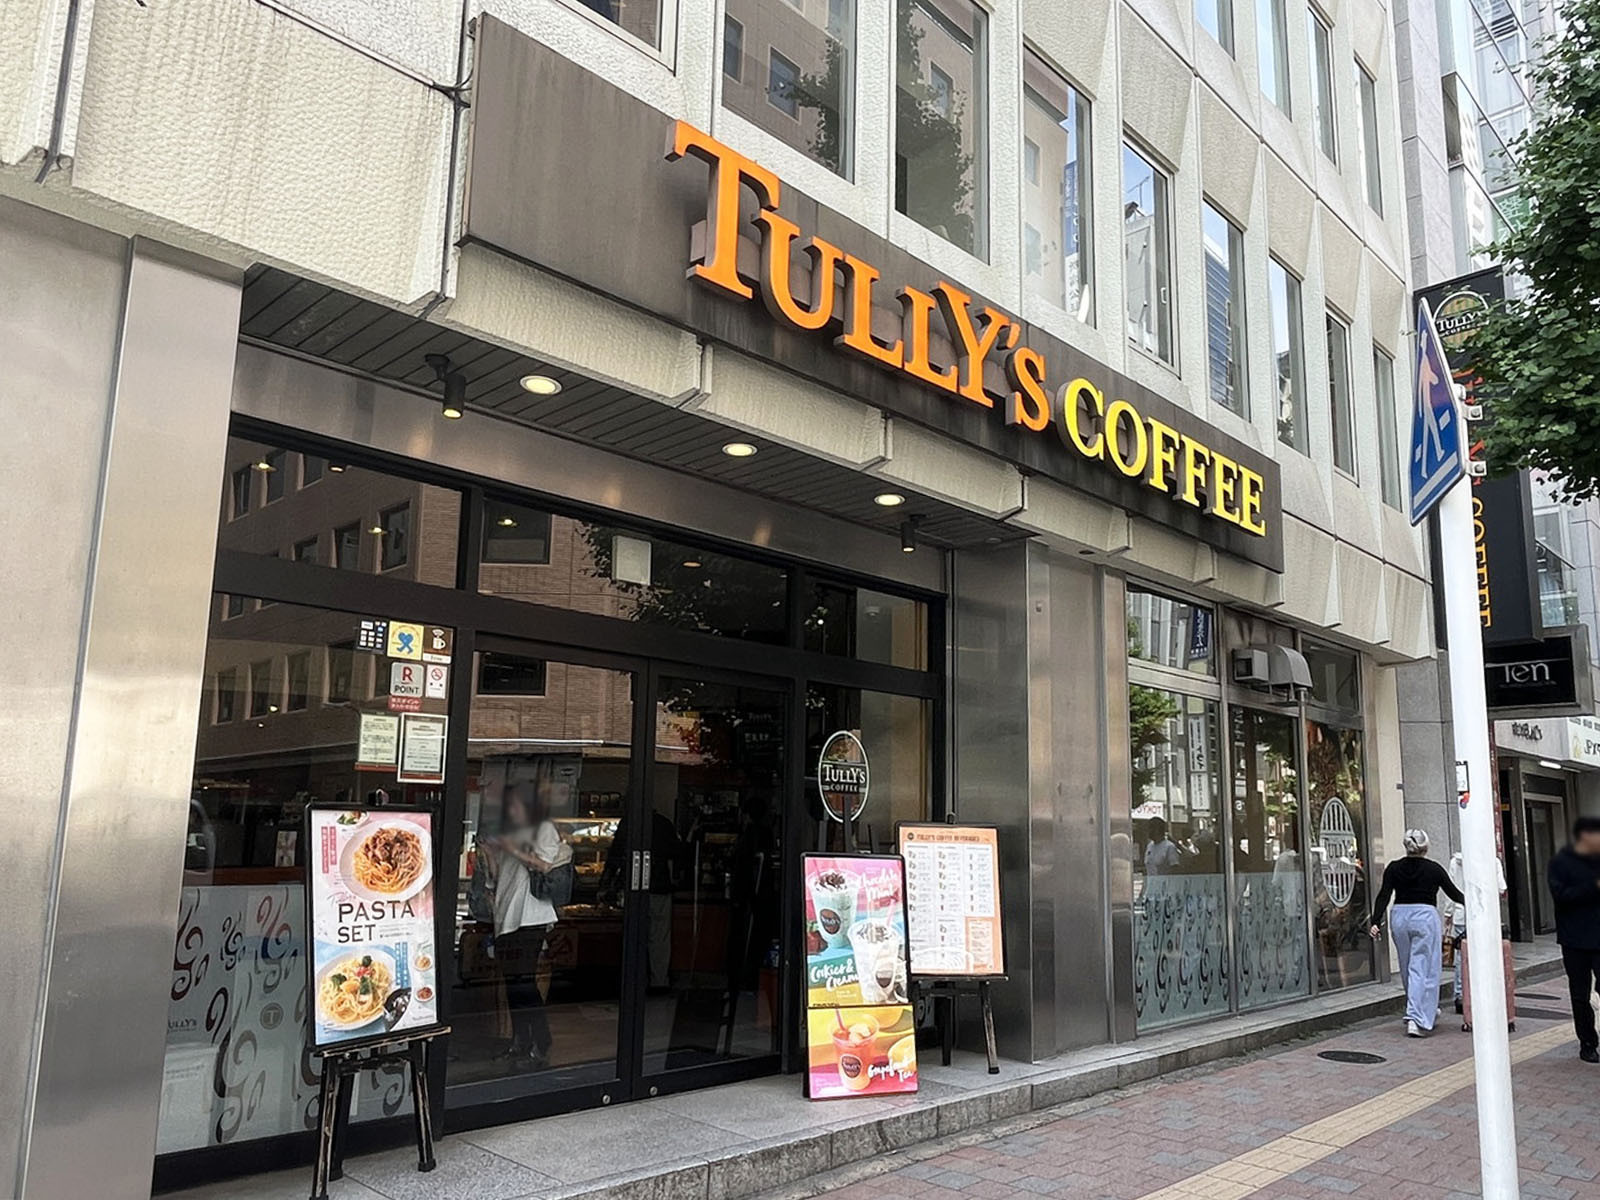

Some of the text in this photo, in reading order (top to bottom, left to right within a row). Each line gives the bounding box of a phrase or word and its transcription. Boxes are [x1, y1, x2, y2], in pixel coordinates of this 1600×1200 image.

[664, 119, 1051, 432] TULLY'S
[1057, 376, 1267, 538] COFFEE
[1437, 310, 1483, 332] TULLY
[394, 684, 419, 695] POINT
[822, 764, 866, 784] TULLY'S
[830, 784, 858, 793] COFFEE
[338, 900, 415, 923] PASTA
[337, 924, 376, 943] SET
